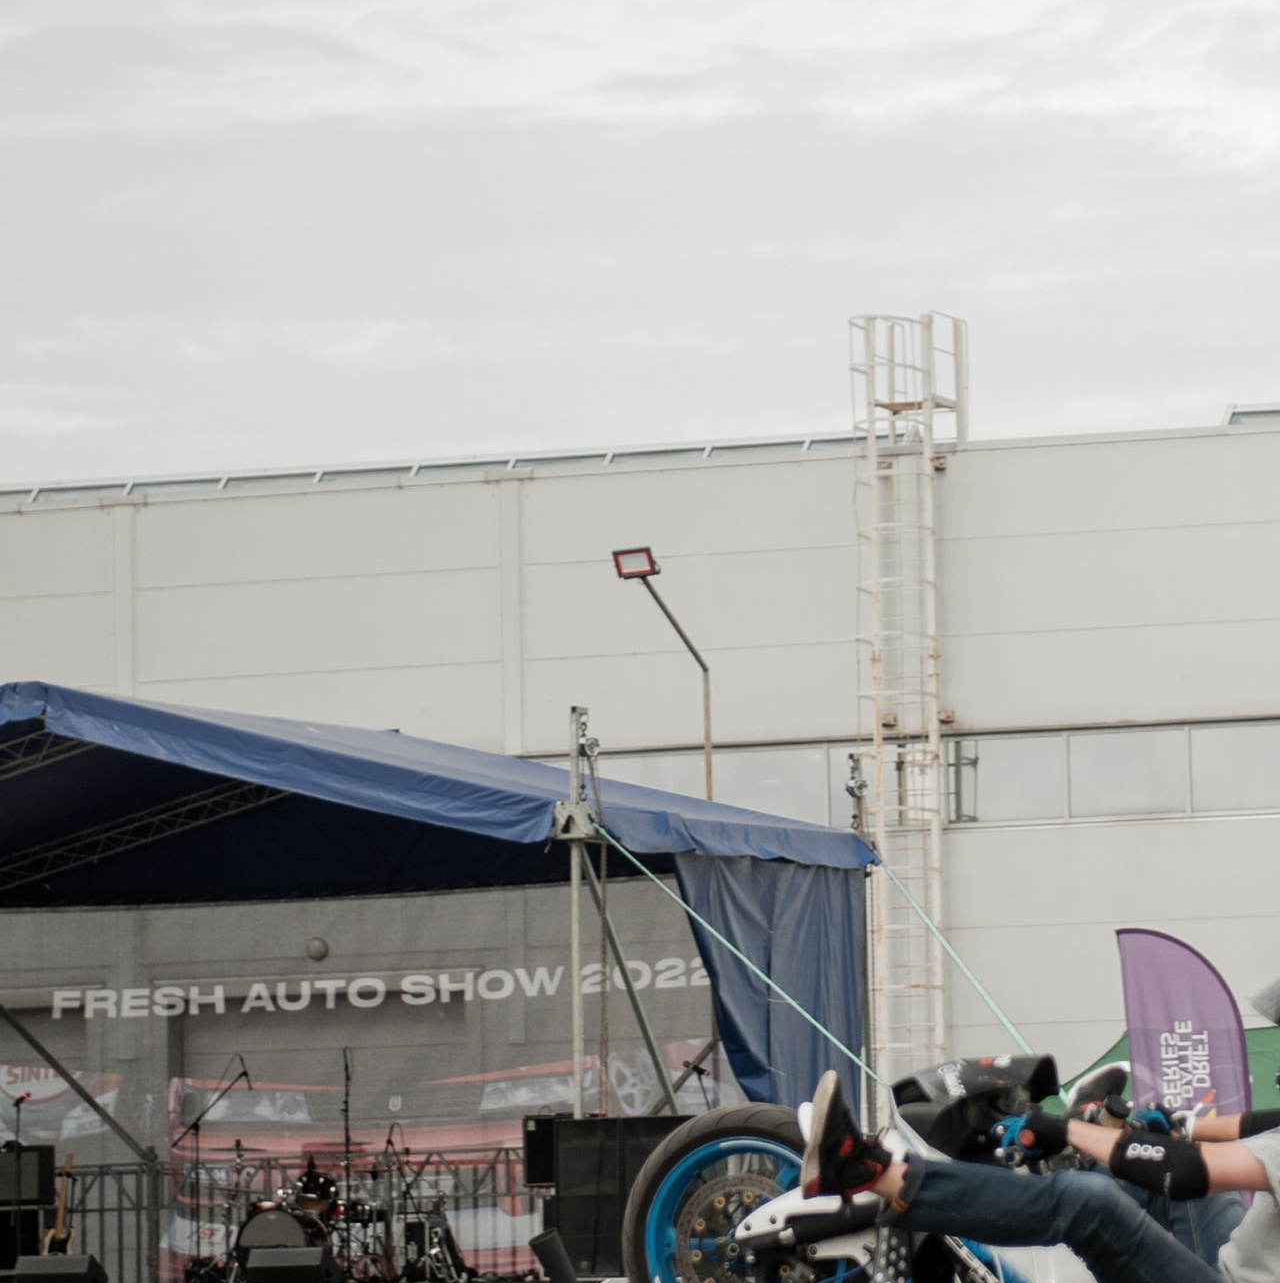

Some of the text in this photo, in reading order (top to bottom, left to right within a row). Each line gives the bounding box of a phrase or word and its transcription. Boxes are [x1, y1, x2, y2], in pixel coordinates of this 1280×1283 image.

[52, 956, 712, 1020] FRESH AUTO SHOW 2022
